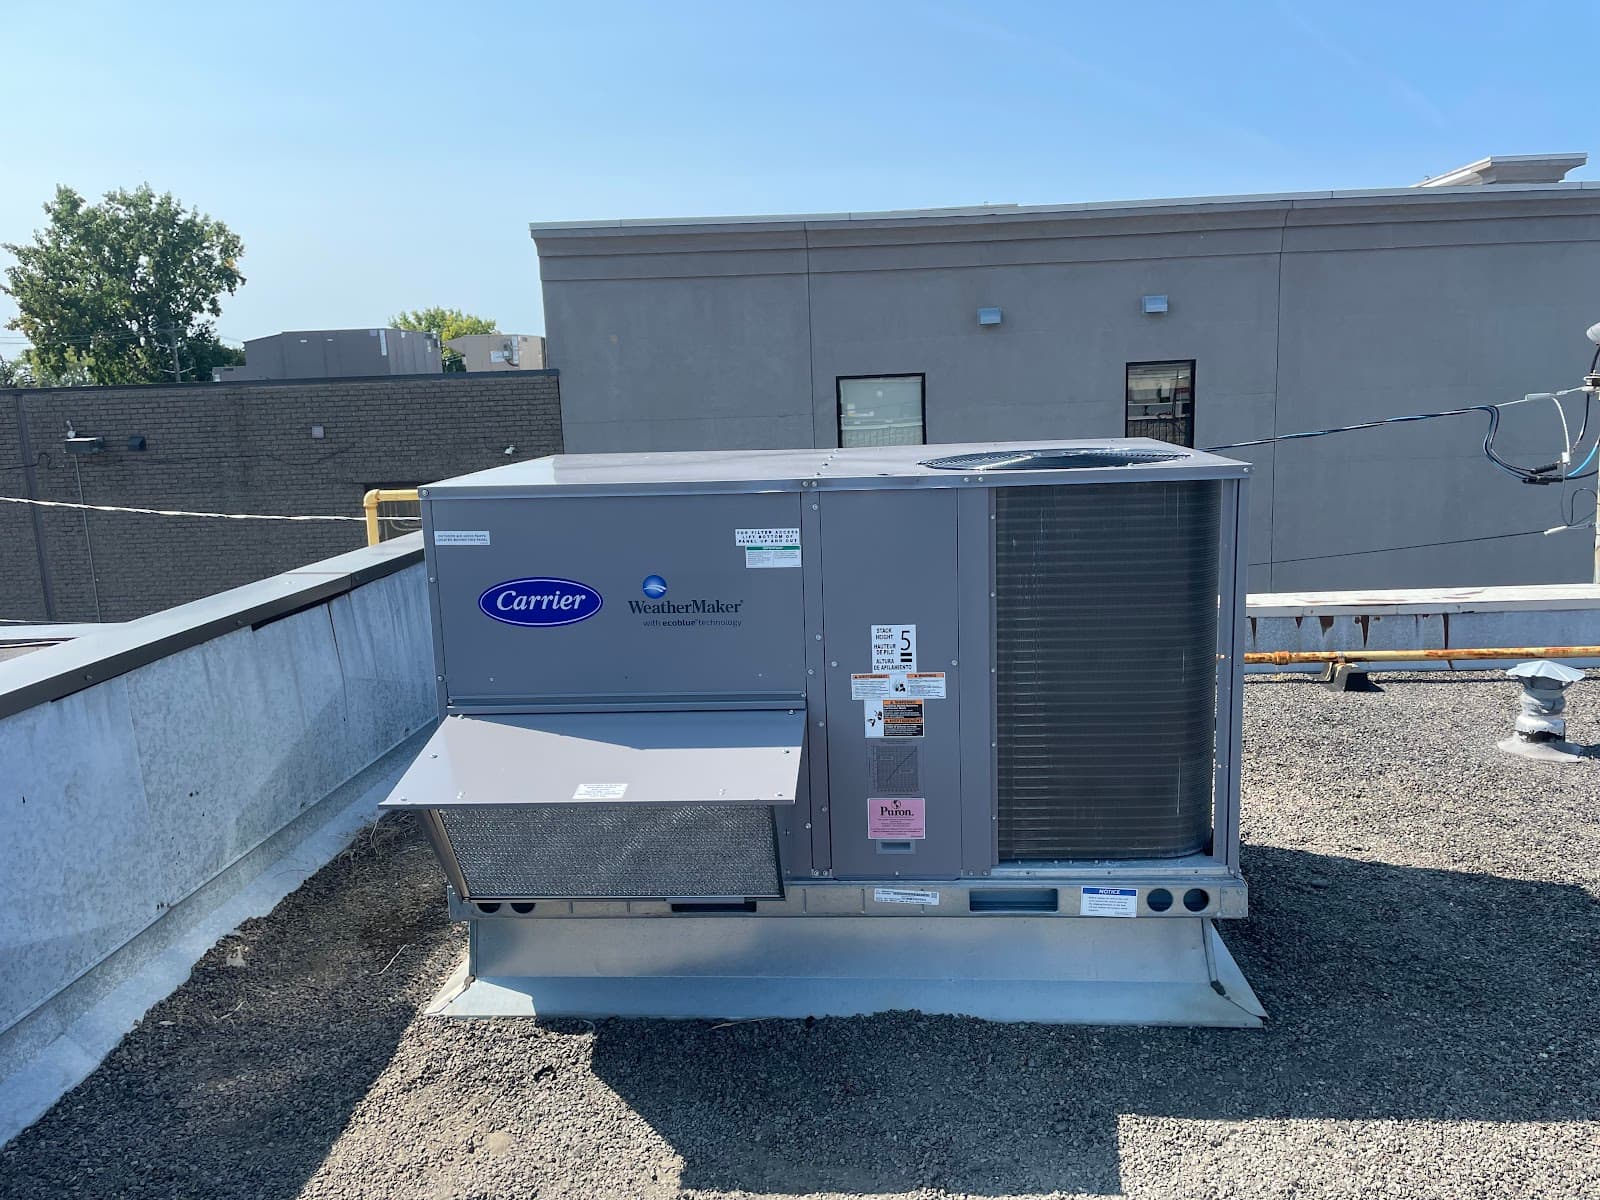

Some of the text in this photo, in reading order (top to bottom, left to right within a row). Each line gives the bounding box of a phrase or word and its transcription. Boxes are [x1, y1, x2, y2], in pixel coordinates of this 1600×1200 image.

[496, 590, 586, 610] Carrier
[698, 619, 742, 628] technology
[900, 630, 911, 650] 5
